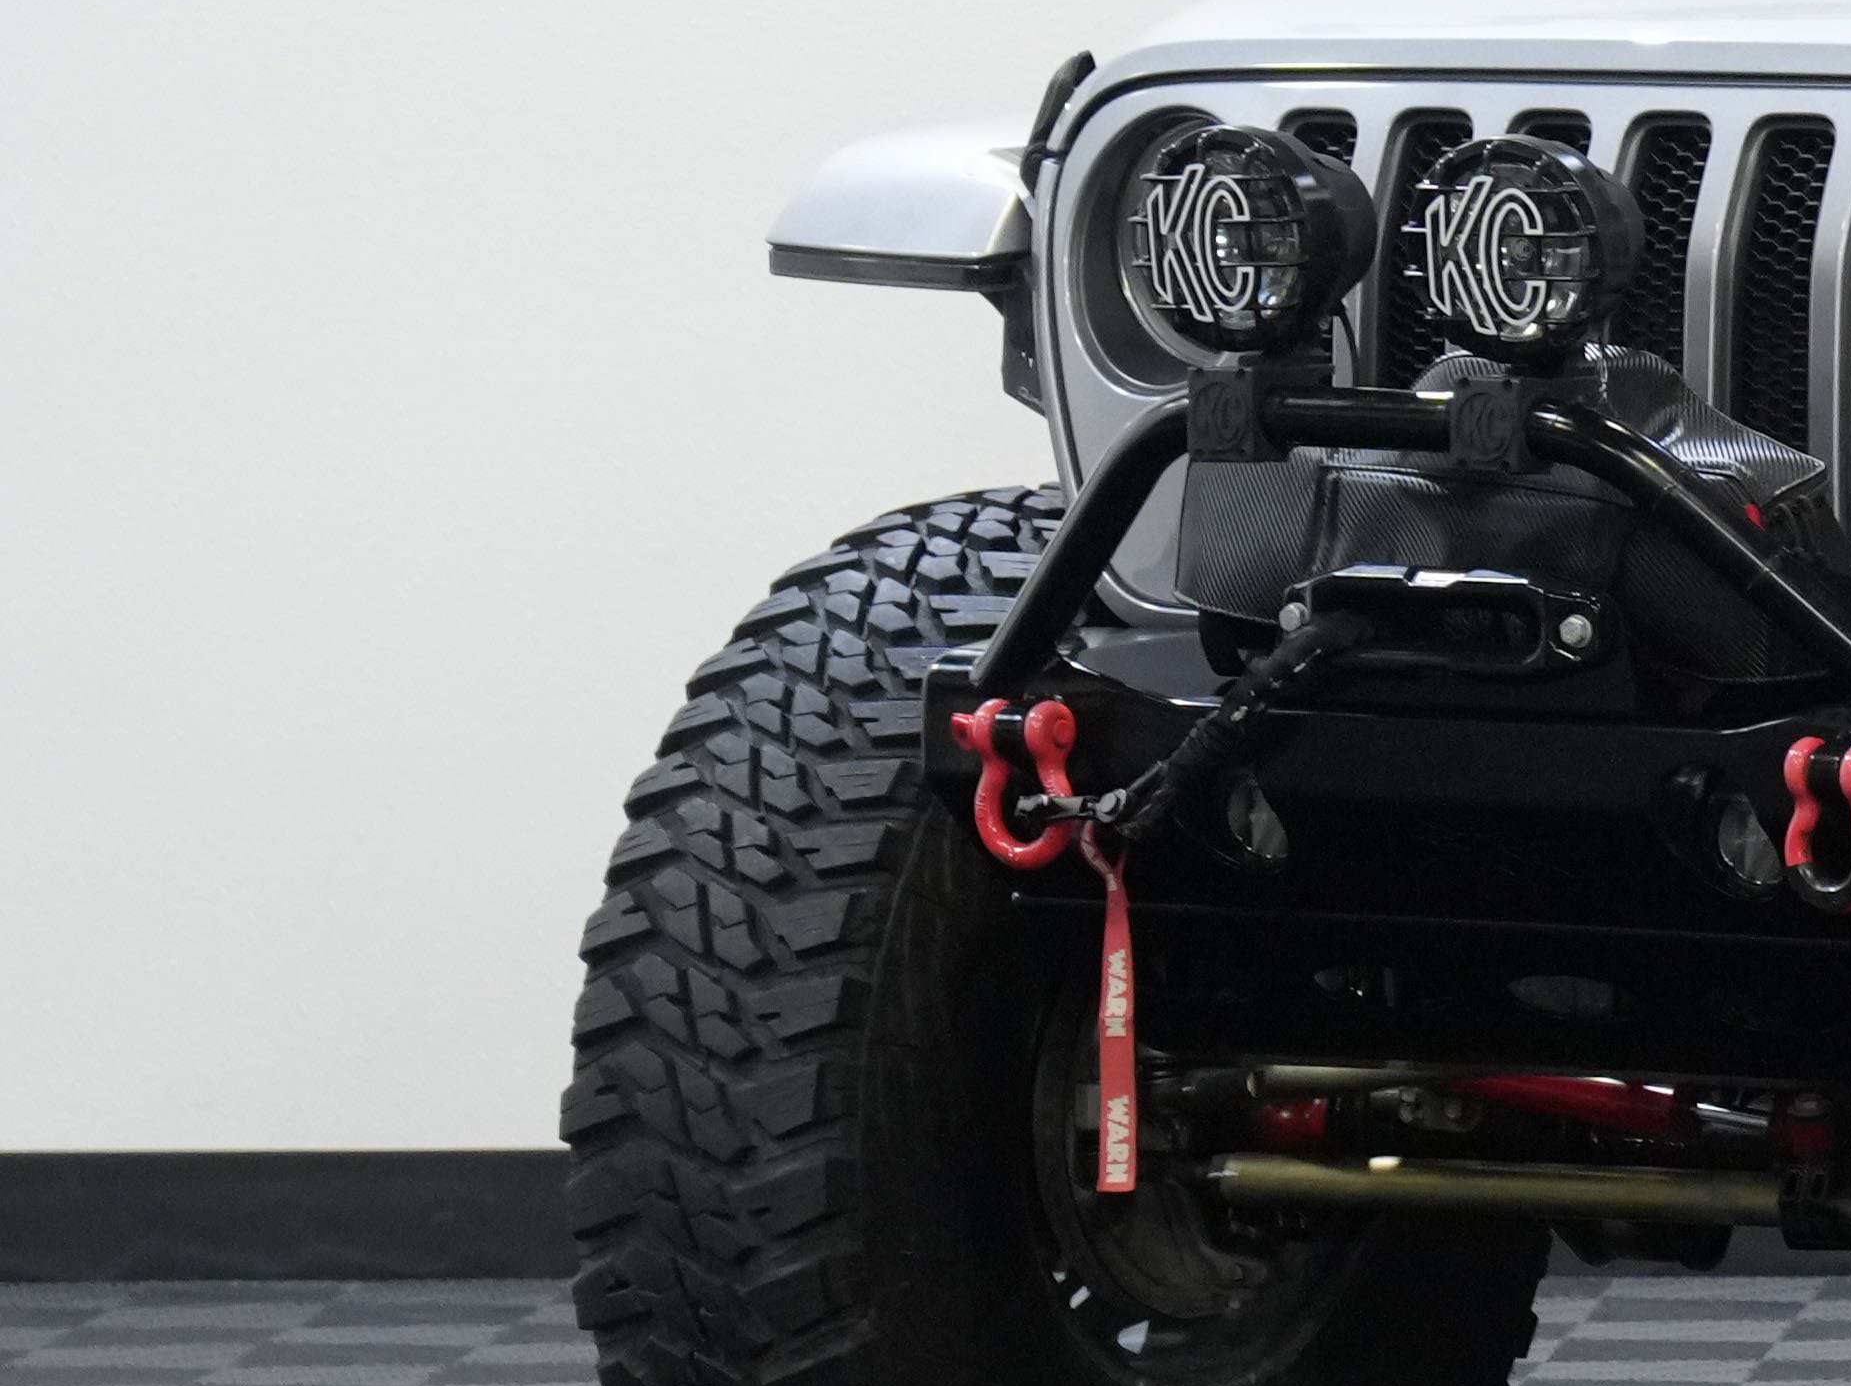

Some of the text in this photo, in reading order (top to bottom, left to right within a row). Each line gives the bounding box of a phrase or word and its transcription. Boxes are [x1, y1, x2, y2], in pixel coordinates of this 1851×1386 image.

[1146, 163, 1255, 324] KC
[1424, 175, 1544, 337] KC
[1105, 949, 1127, 1037] WARN
[1105, 1094, 1131, 1184] WARN
